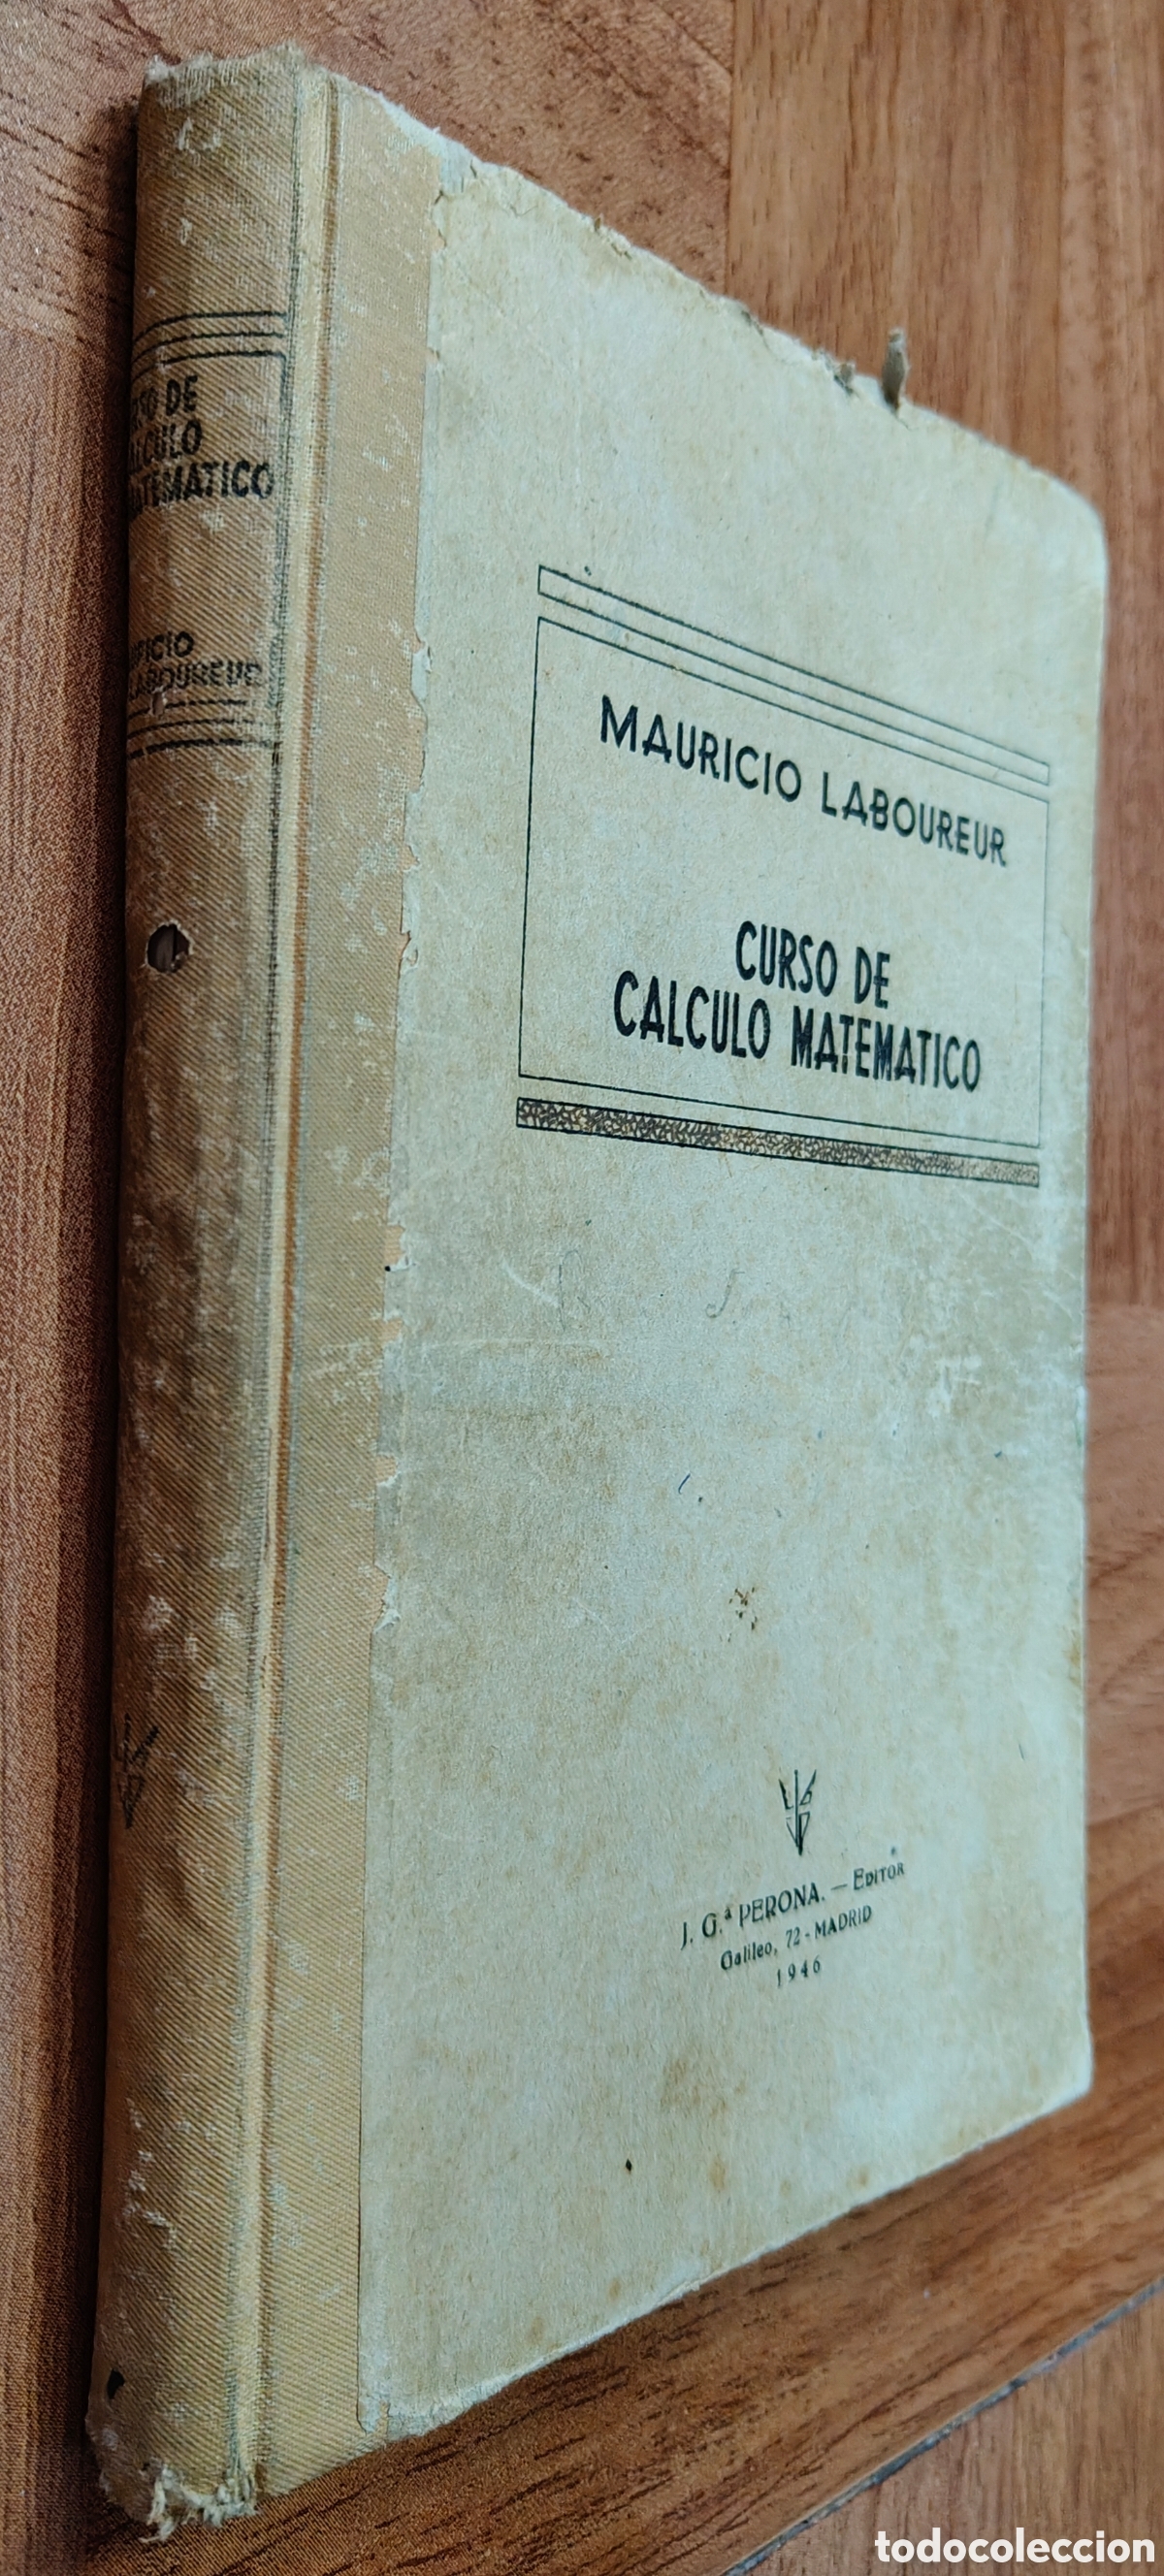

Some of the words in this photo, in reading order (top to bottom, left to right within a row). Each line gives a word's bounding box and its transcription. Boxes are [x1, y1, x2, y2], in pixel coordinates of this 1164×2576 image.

[166, 375, 199, 416] DE
[127, 460, 275, 518] ATEMATICO
[599, 694, 802, 803] MAURICIO
[821, 771, 1007, 867] LABOUREUR
[735, 920, 838, 997] CURSO
[854, 946, 890, 1010] DE
[613, 970, 771, 1059] CALCULO
[791, 1005, 982, 1092] MATEMATICO
[680, 1921, 694, 1950] J.
[738, 1882, 825, 1928] PERONA.
[720, 1941, 778, 1971] Galileo,
[776, 1954, 822, 1988] 1946
